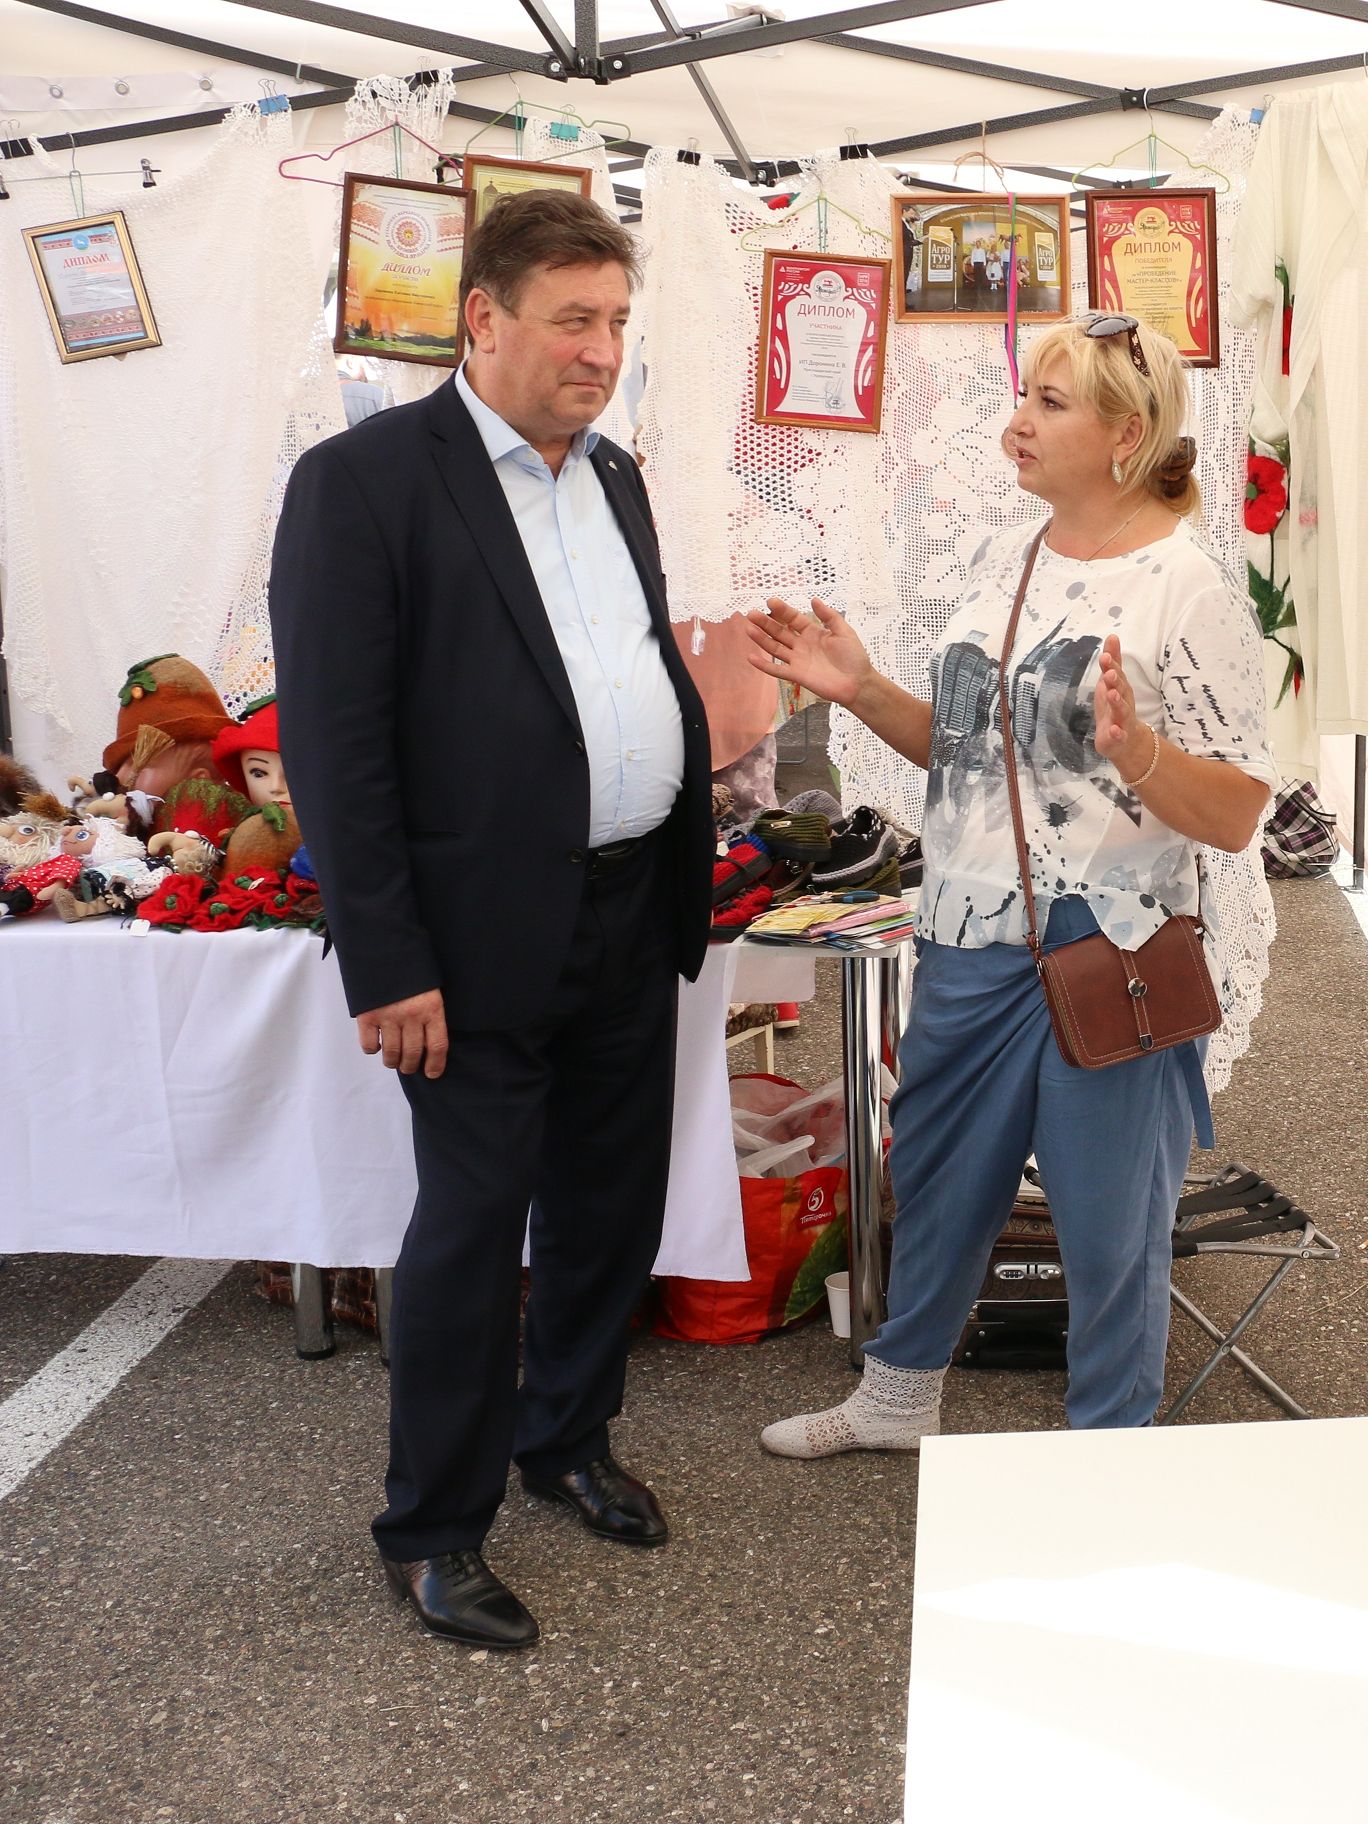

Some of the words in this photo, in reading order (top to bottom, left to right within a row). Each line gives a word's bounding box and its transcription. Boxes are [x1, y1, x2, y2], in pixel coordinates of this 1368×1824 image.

[1124, 241, 1181, 256] ДИПЛОМ
[63, 253, 110, 269] ДИПЛОМ
[931, 254, 951, 264] ТУР
[1038, 256, 1054, 266] ТУР
[381, 262, 431, 277] ДИПЛОМ
[797, 303, 856, 319] ДИПЛОМ
